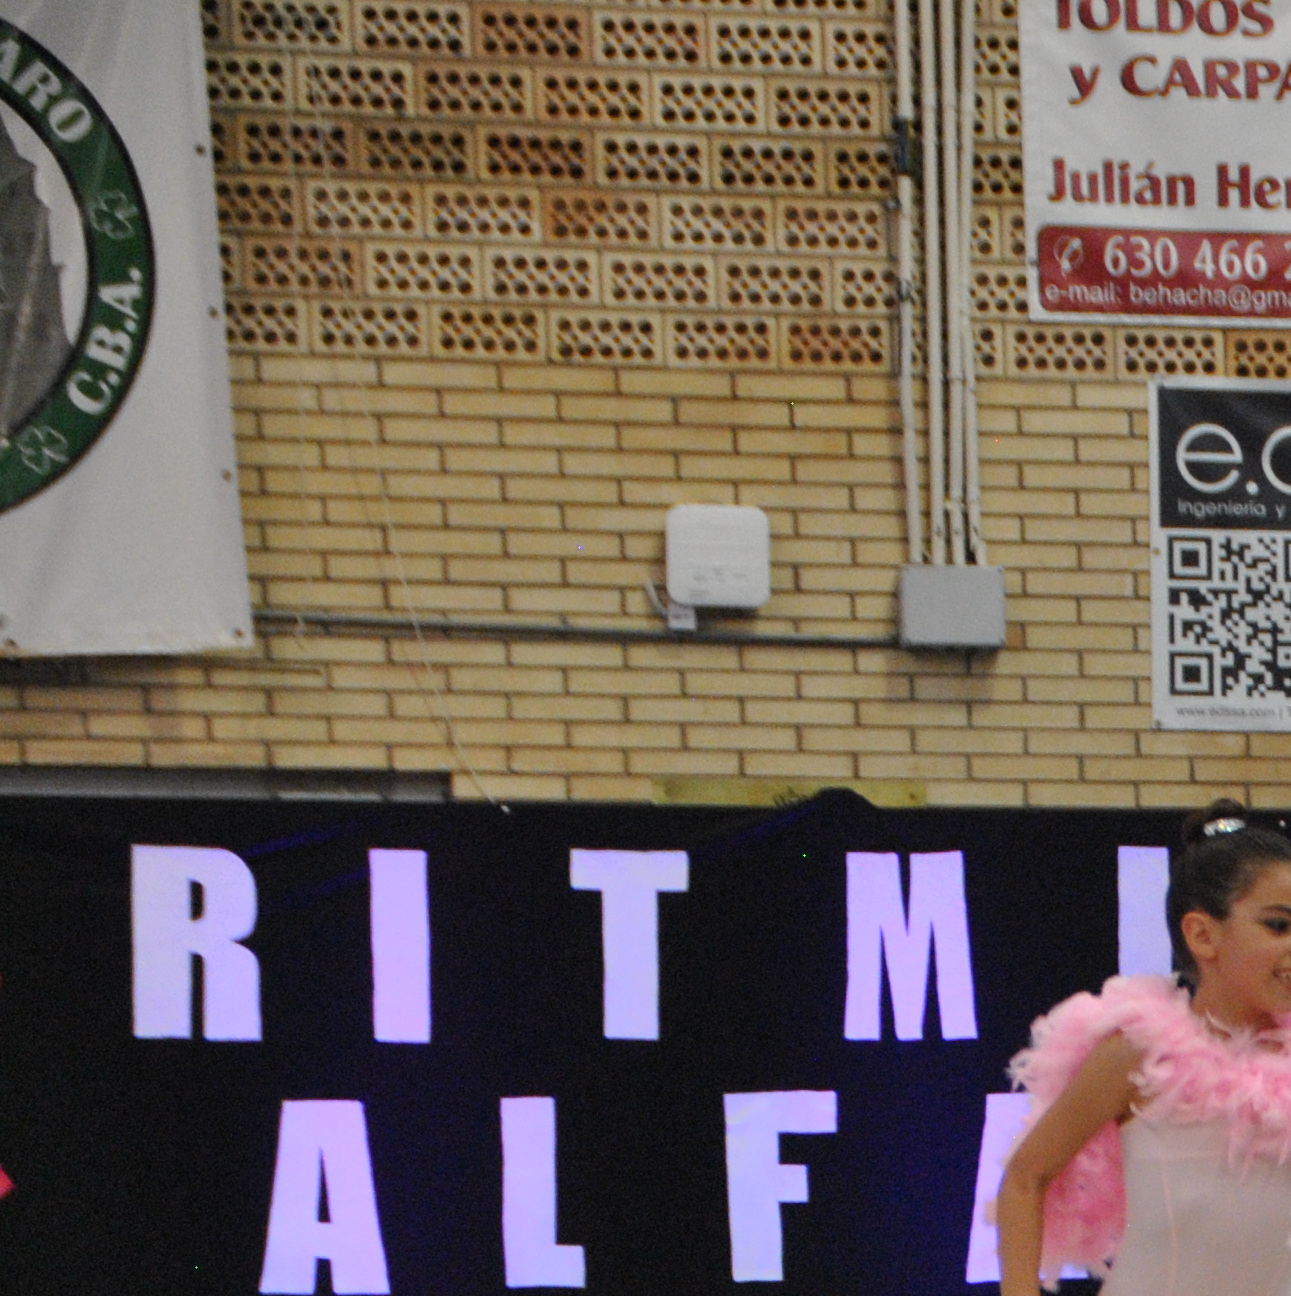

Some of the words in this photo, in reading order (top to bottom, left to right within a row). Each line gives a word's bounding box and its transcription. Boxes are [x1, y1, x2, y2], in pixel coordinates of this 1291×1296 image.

[1068, 64, 1100, 104] y
[1048, 158, 1196, 206] Julián
[1104, 235, 1179, 278] 630
[1194, 239, 1268, 281] 466
[1275, 505, 1285, 519] y
